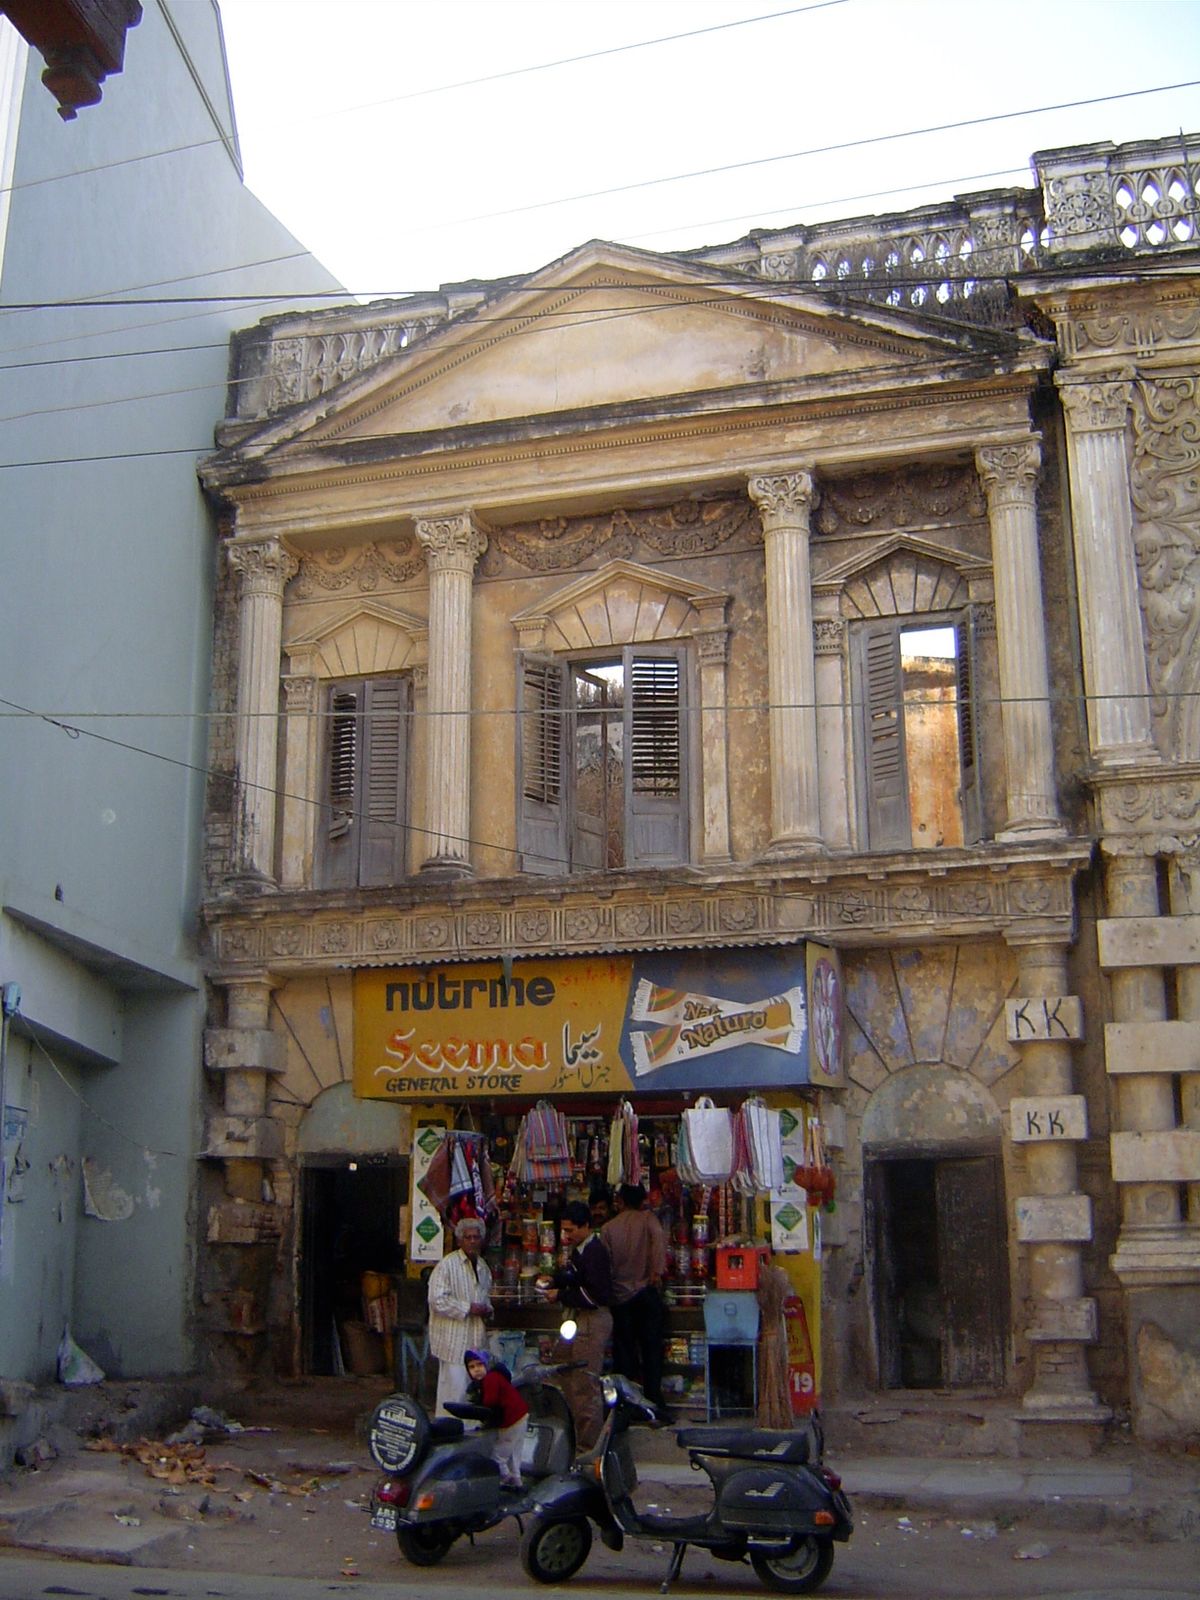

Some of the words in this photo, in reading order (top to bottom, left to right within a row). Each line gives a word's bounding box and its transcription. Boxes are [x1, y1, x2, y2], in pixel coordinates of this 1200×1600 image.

[374, 1028, 550, 1076] Seema
[386, 1077, 459, 1093] GENERAL
[466, 1074, 522, 1092] STORE
